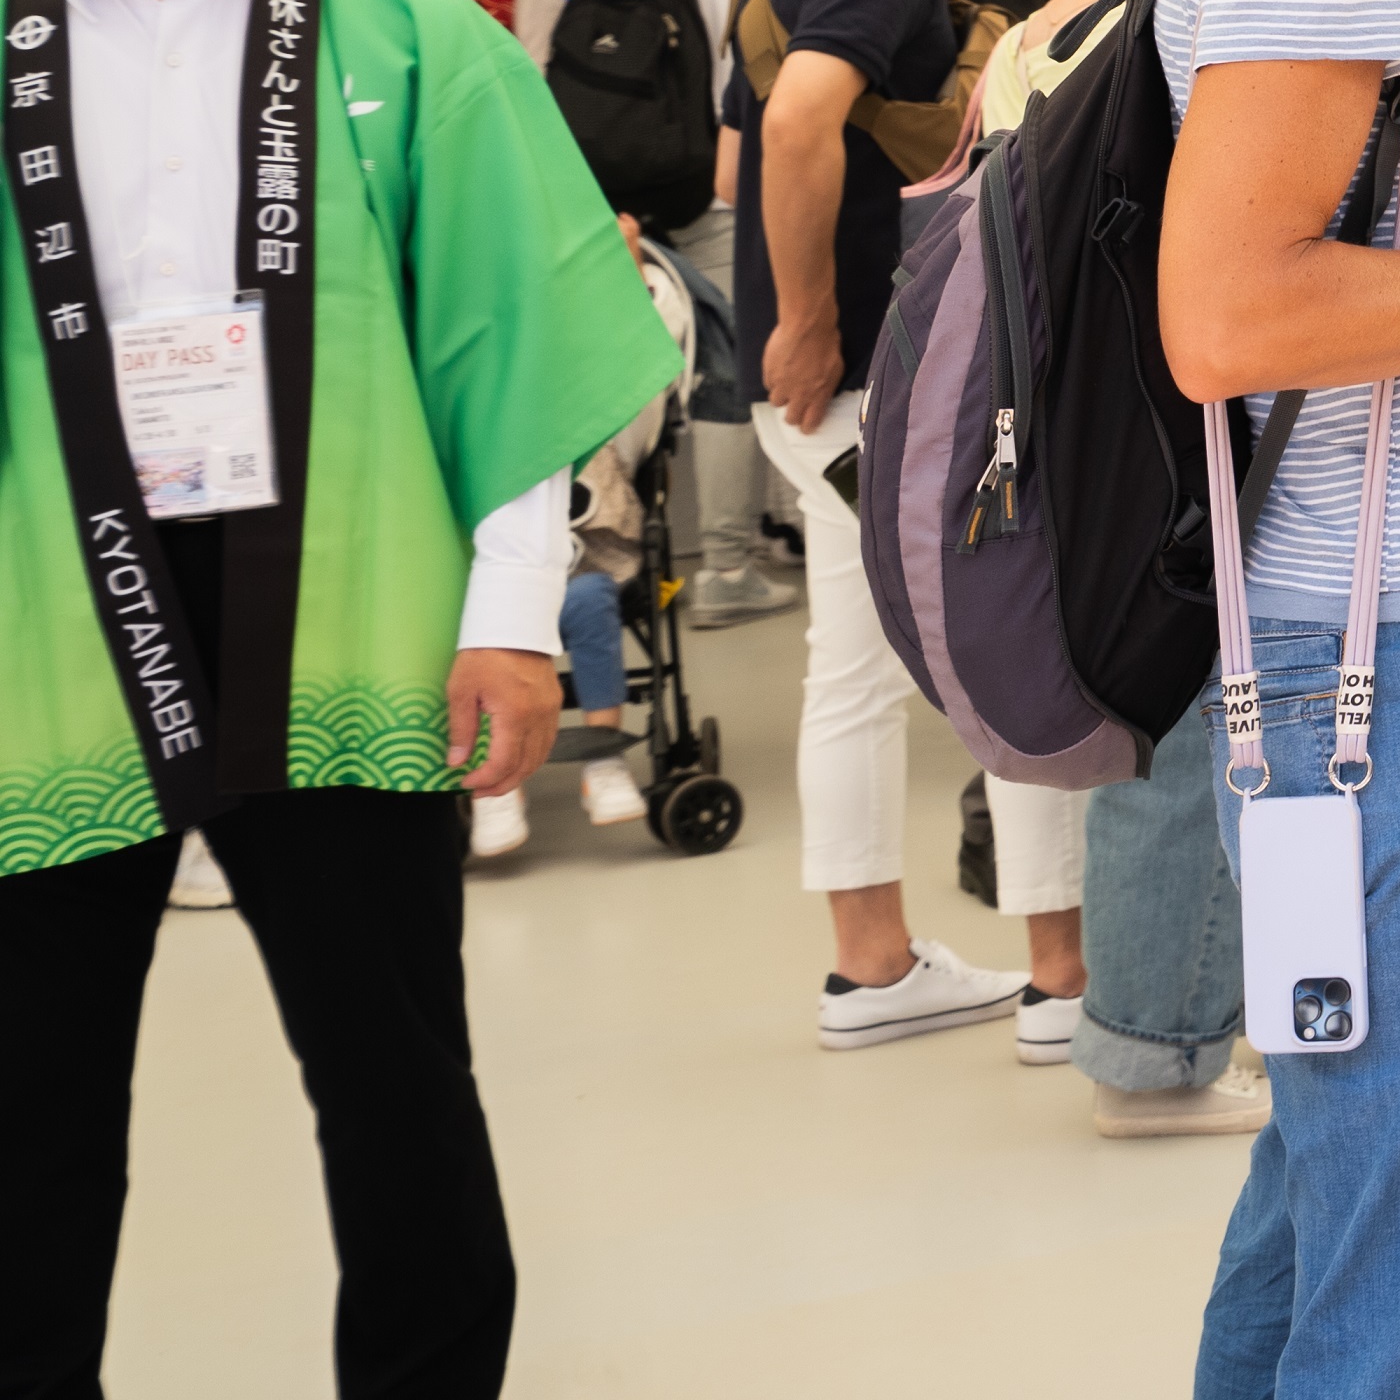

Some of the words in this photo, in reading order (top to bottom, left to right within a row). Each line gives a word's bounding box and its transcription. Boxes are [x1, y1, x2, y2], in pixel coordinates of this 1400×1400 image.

[9, 71, 90, 341] 京田辺市
[123, 351, 158, 372] DAY
[167, 345, 215, 367] PASS
[88, 507, 203, 761] KYOTANABE
[1229, 717, 1262, 734] LIVE
